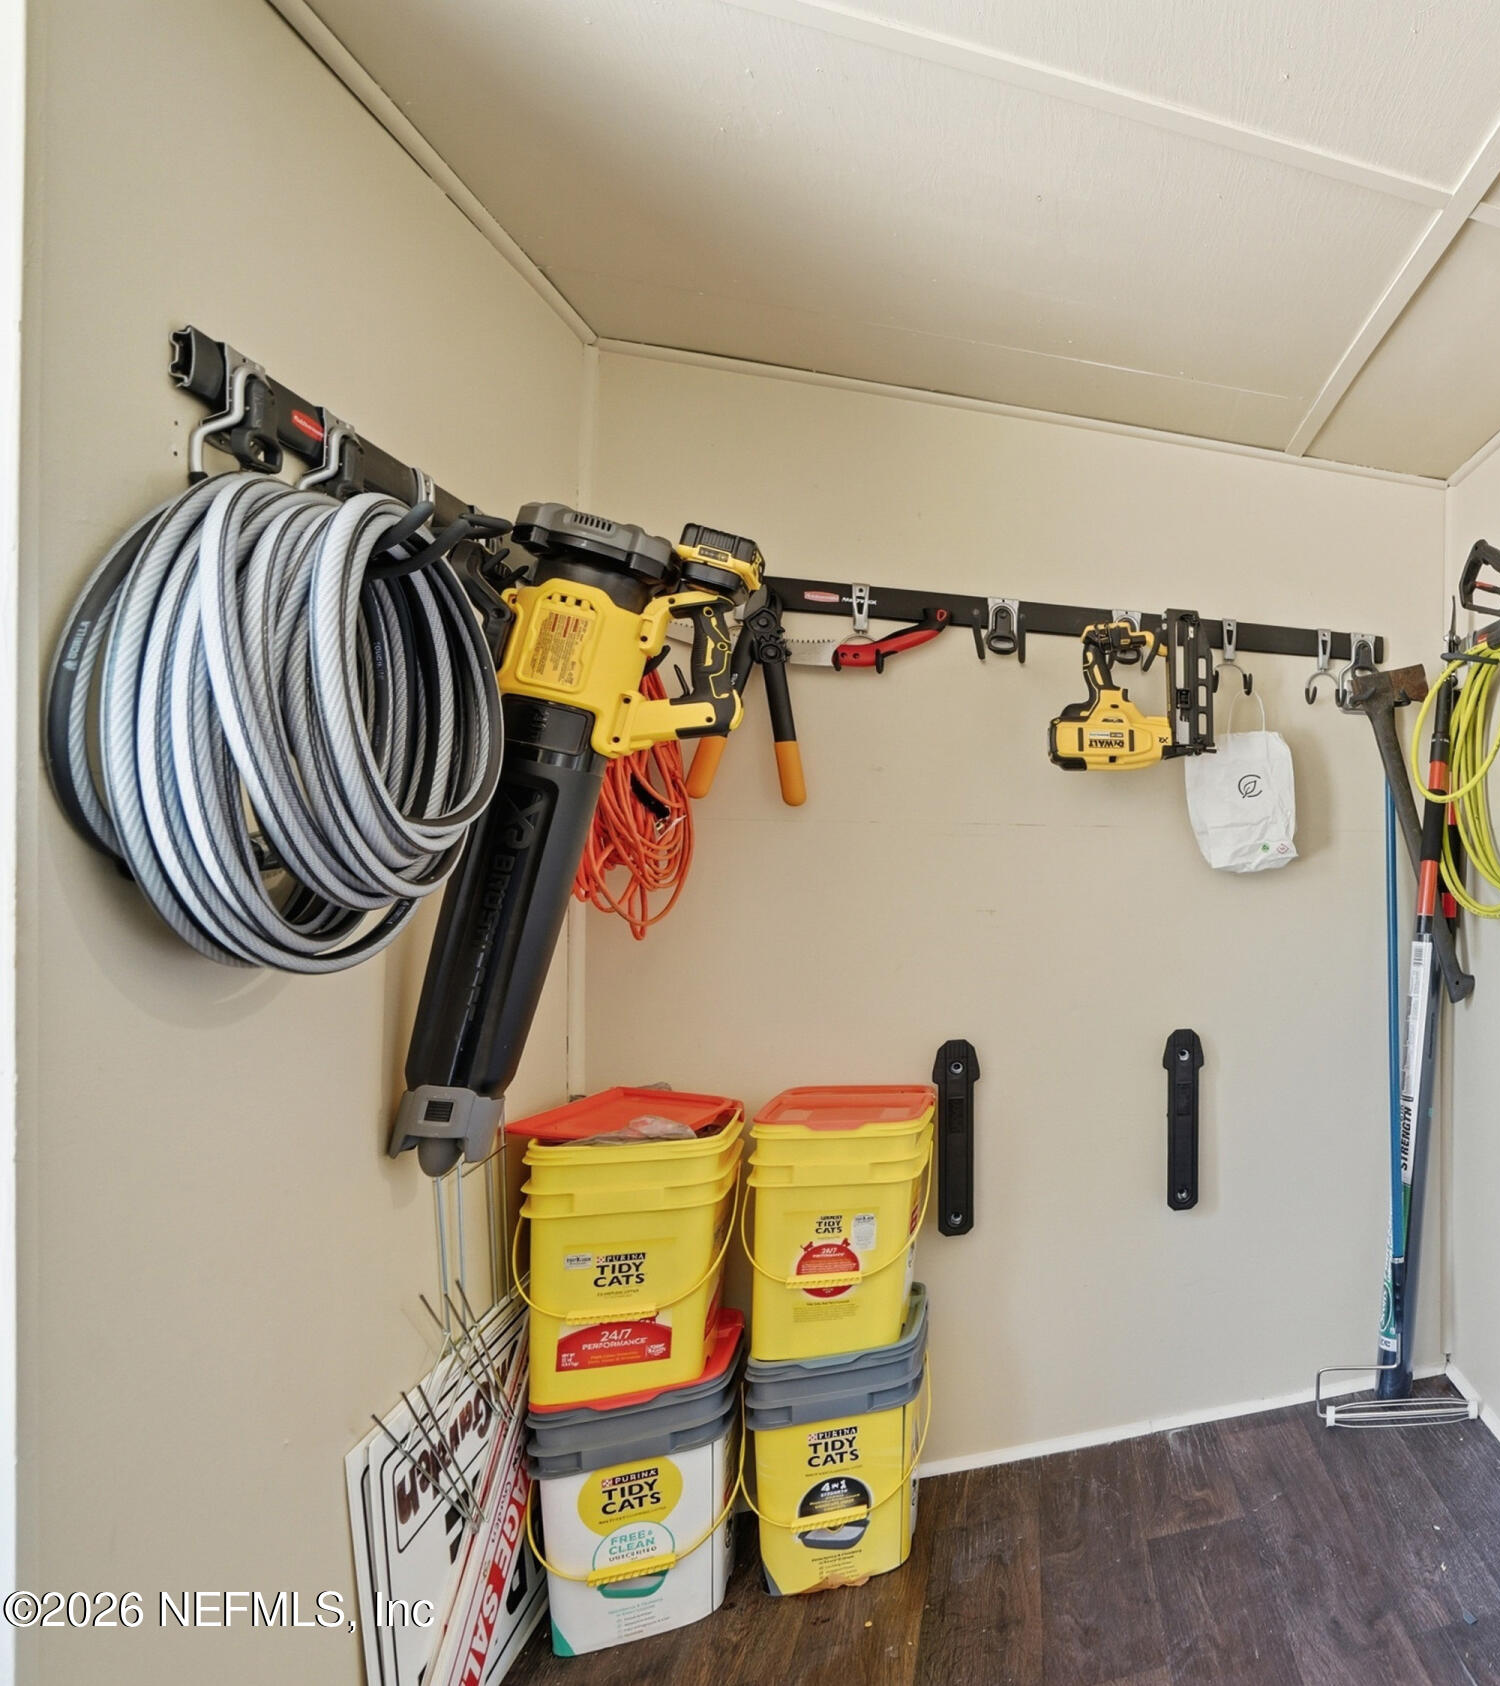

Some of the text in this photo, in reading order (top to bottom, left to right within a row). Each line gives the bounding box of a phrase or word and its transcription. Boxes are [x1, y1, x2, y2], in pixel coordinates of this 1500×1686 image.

[596, 1261, 644, 1276] TIDY
[593, 1273, 645, 1288] CATS
[581, 1337, 648, 1350] PERFORMANCE
[600, 1328, 633, 1342] 24/7
[808, 1436, 856, 1454] TIDY
[807, 1449, 859, 1468] CATS
[613, 1468, 658, 1485] PURINA
[602, 1479, 658, 1500] TIDY
[601, 1492, 661, 1515] CATS
[608, 1537, 655, 1555] CLEAN
[610, 1530, 645, 1545] FREE
[460, 1583, 500, 1686] SAL
